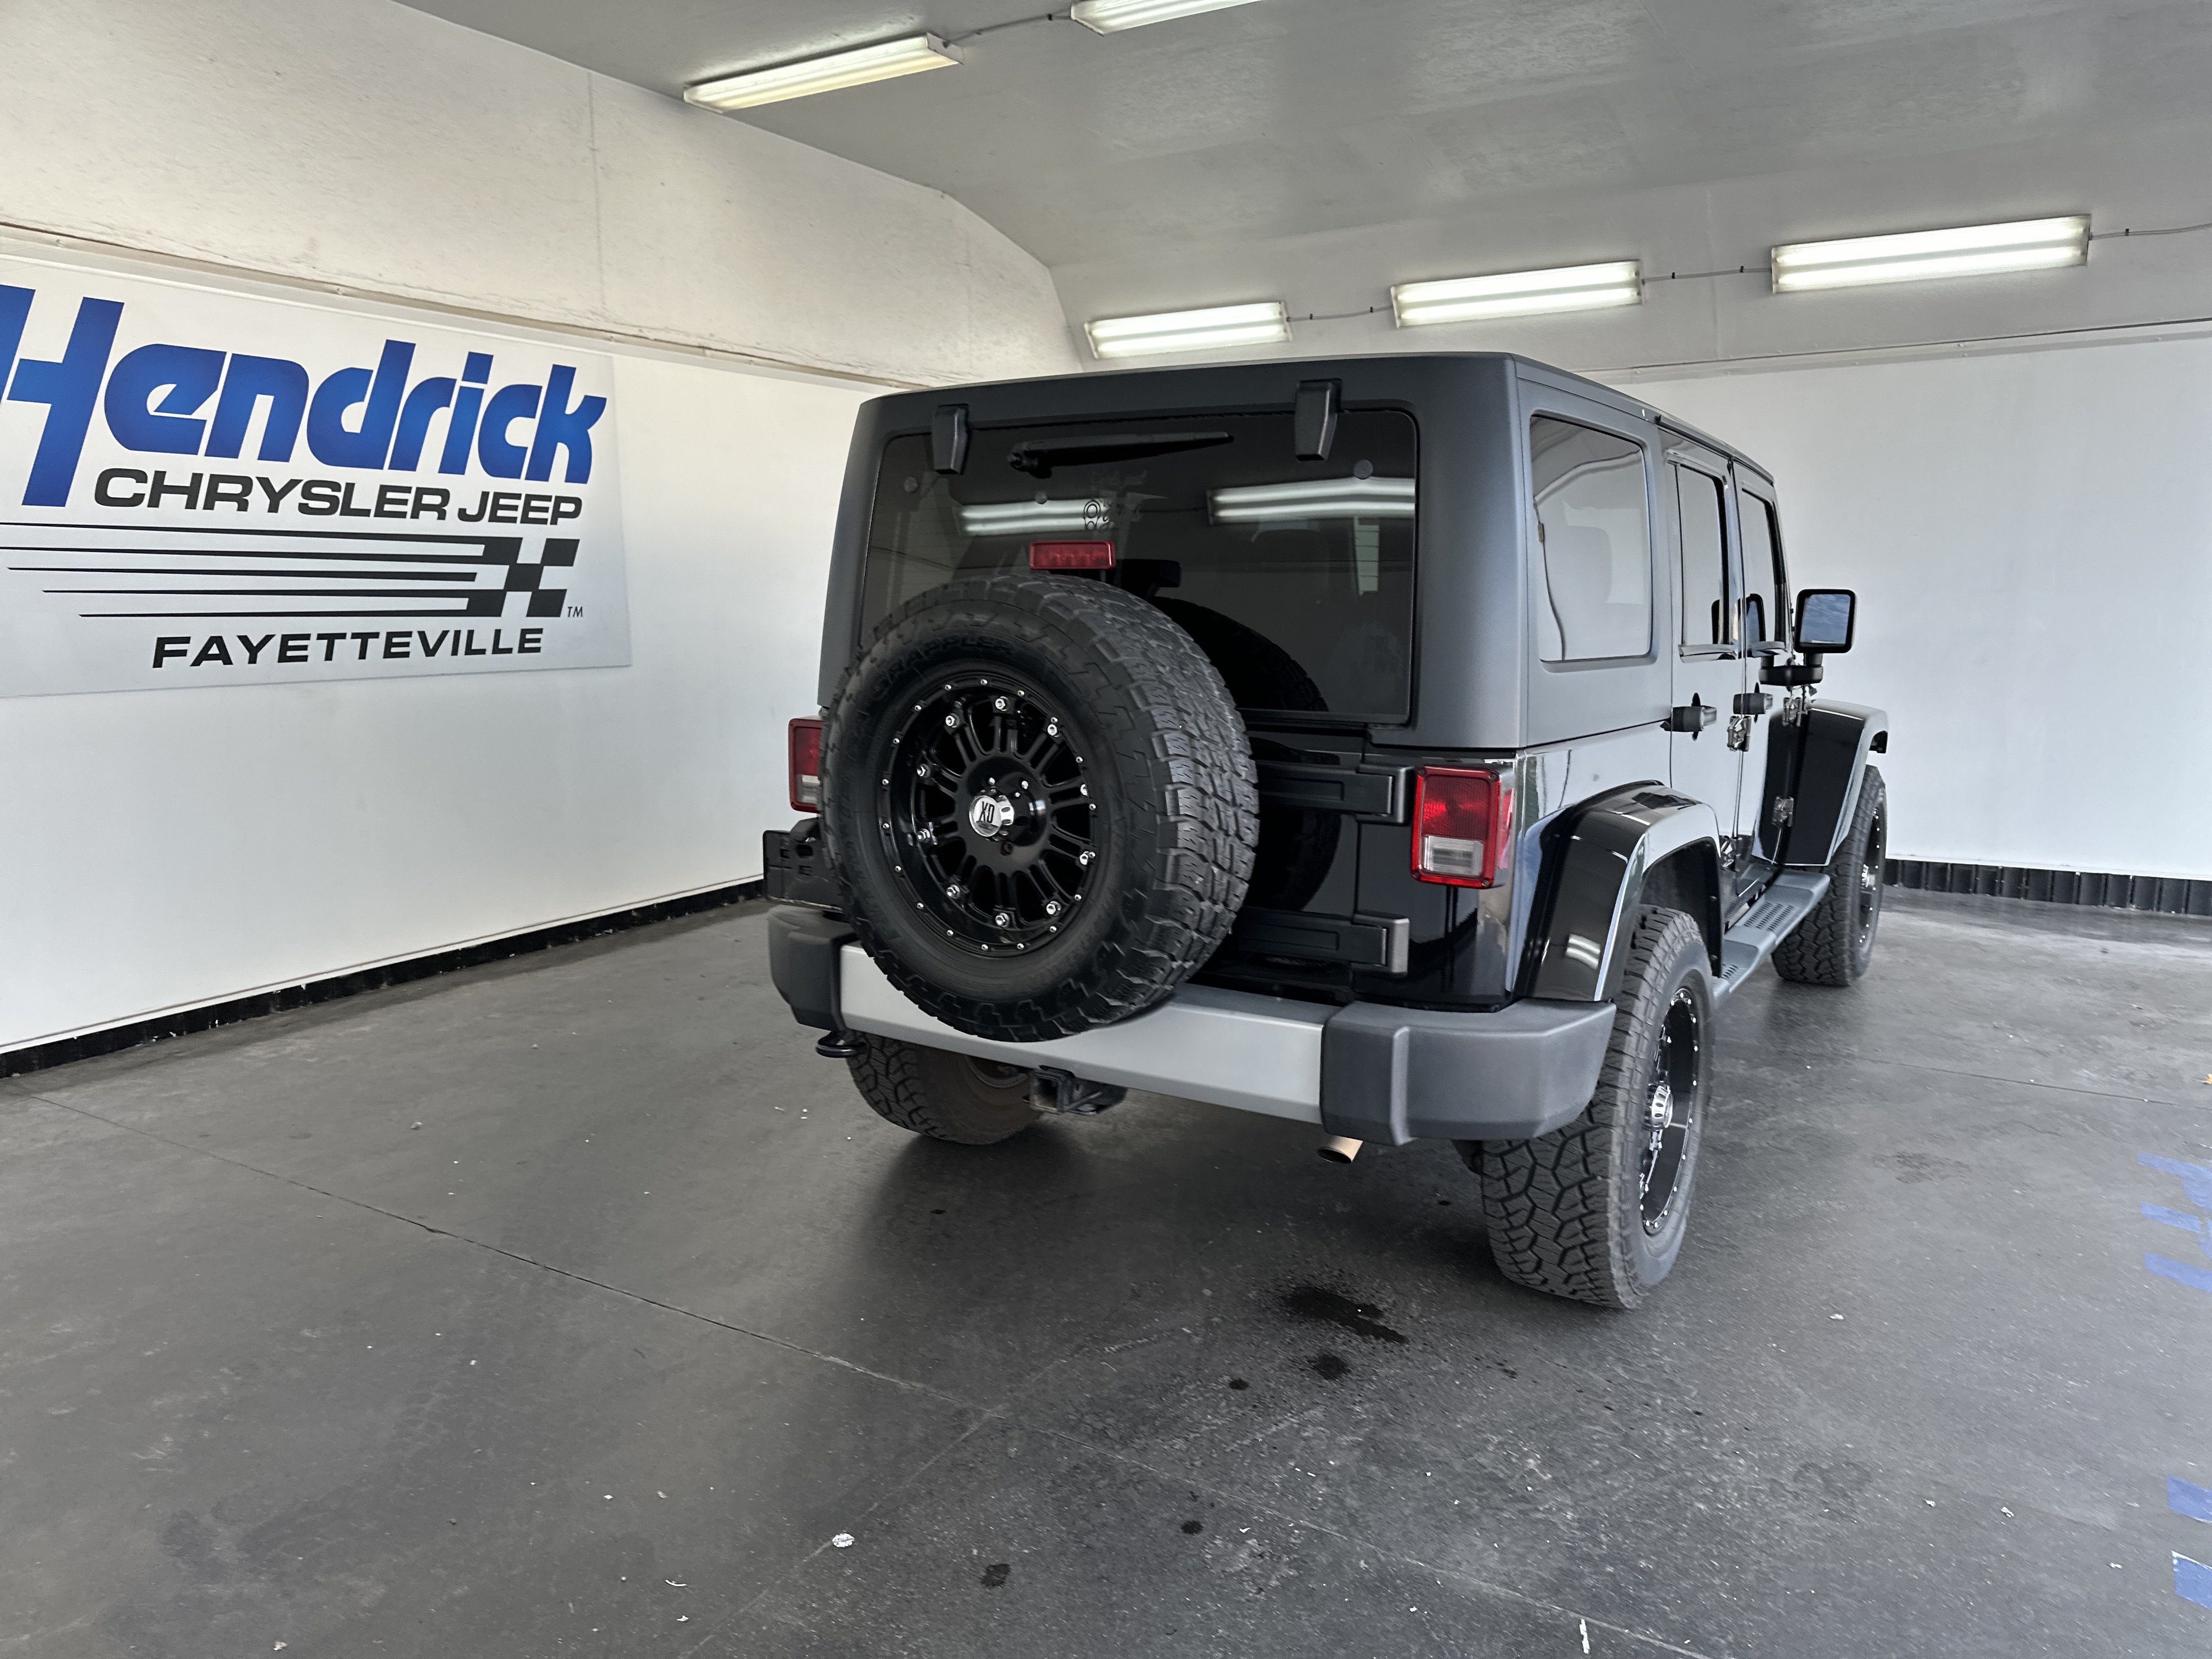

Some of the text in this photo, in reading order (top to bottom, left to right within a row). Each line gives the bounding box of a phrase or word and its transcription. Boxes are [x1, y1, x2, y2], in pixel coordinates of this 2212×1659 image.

[0, 284, 606, 506] Hendrick
[95, 468, 582, 526] CHRYSLER JEEP
[567, 606, 583, 618] TM
[152, 628, 544, 668] FAYETTEVILLE
